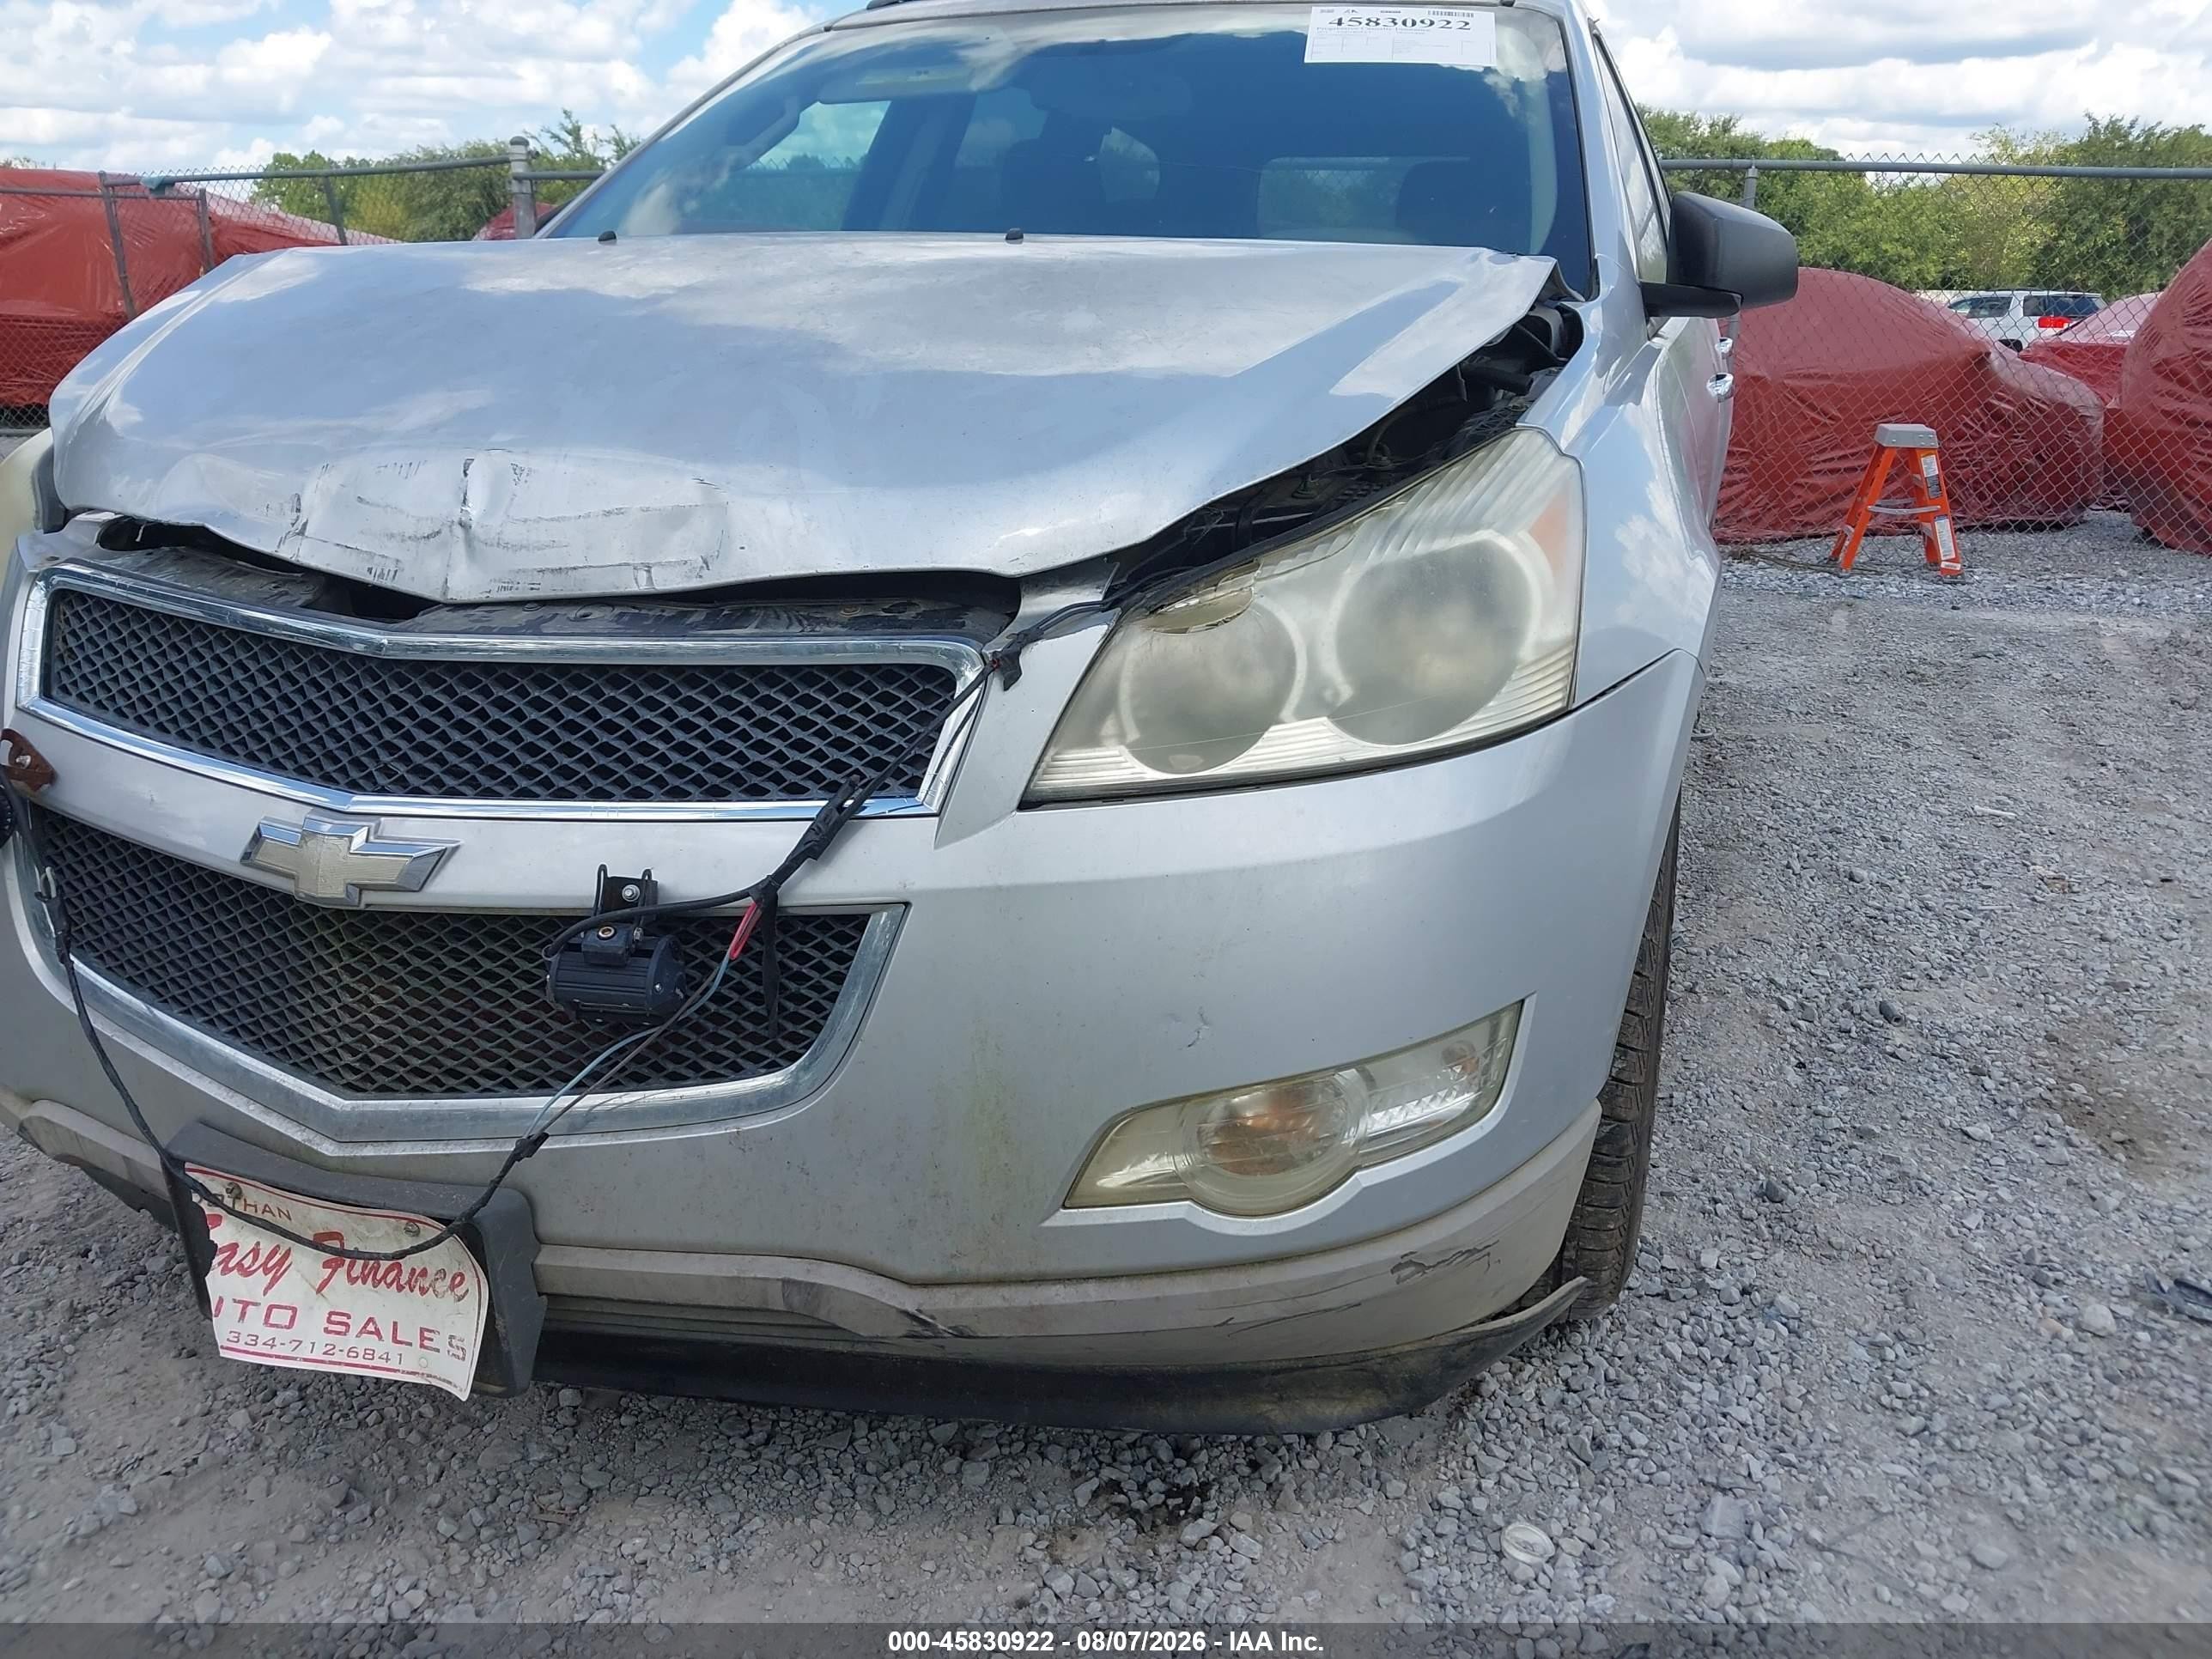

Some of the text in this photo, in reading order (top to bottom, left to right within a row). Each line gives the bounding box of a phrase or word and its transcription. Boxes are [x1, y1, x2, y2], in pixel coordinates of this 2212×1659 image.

[1328, 16, 1472, 31] 45830922
[313, 1231, 469, 1302] Finance
[227, 1331, 403, 1365] 334-712-6841
[323, 1311, 467, 1362] SALES
